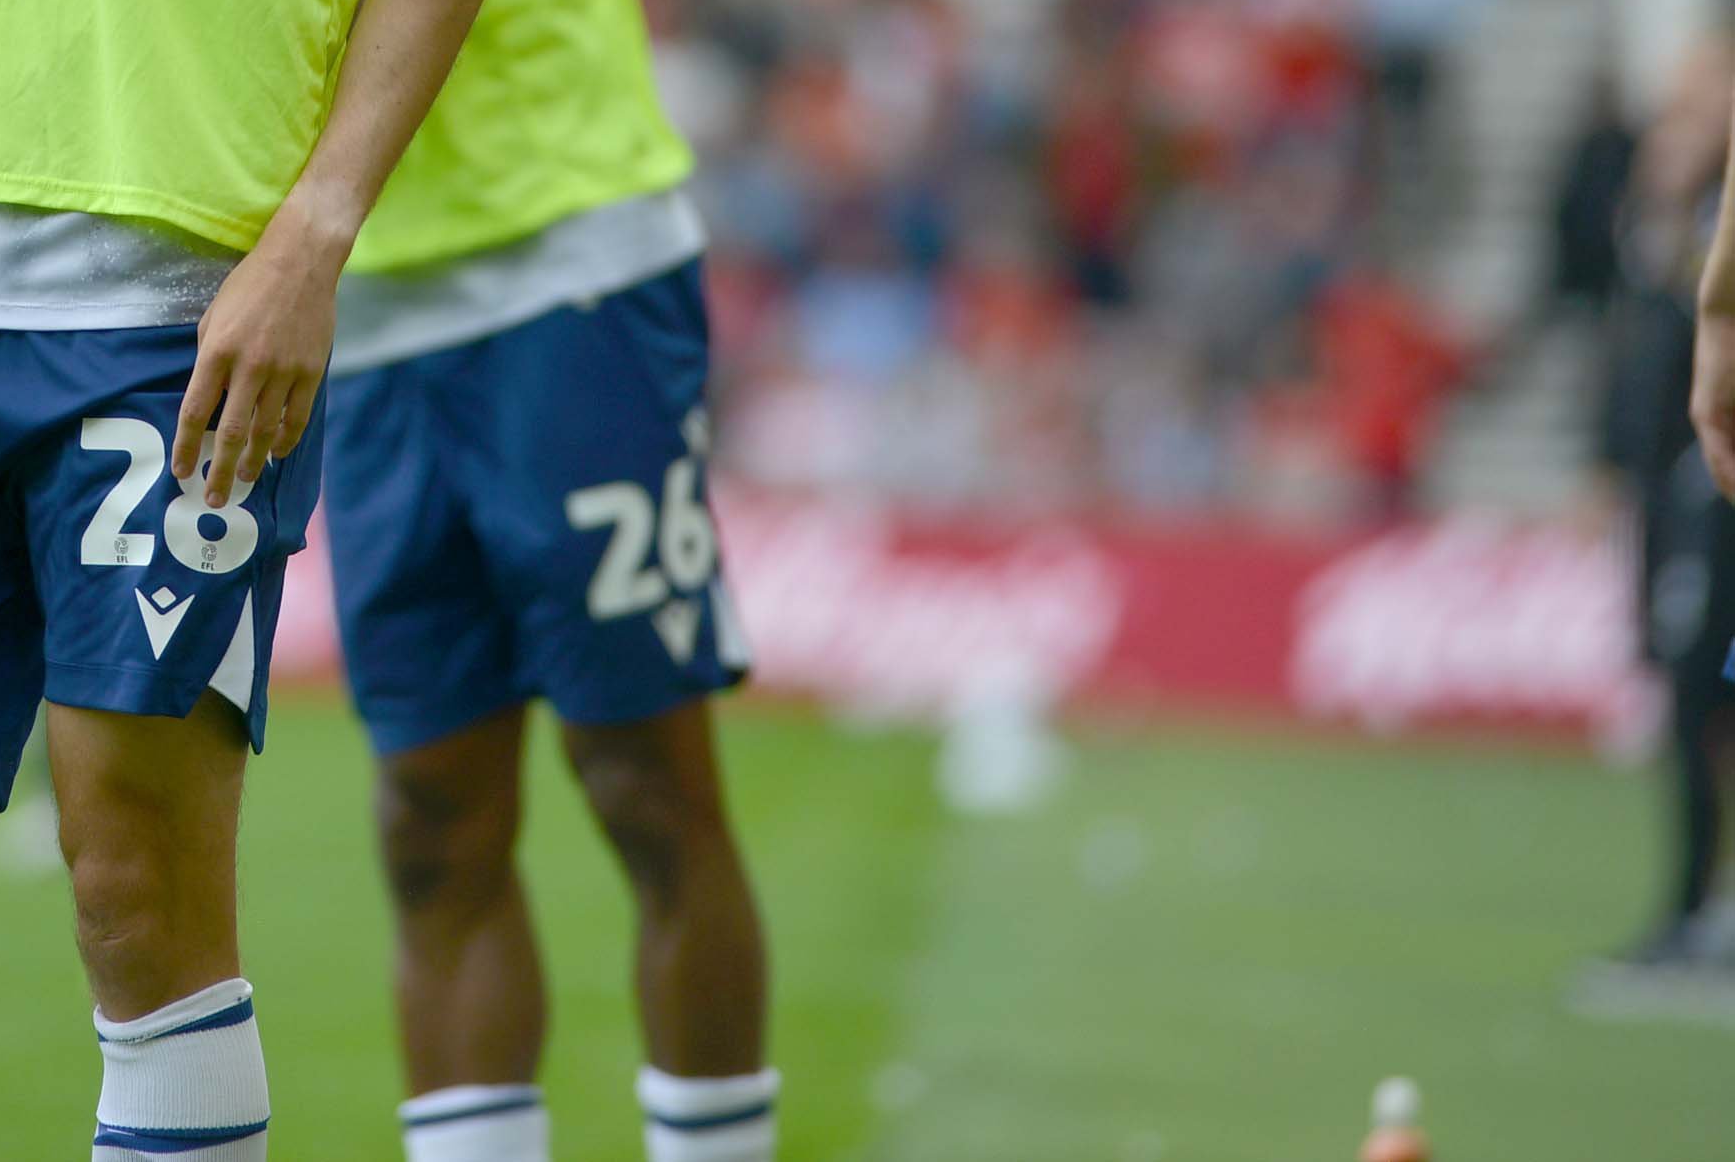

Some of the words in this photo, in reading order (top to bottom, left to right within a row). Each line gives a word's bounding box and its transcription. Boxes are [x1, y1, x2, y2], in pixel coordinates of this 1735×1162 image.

[565, 454, 718, 624] 26
[115, 554, 129, 564] EFL
[200, 561, 215, 572] EFL
